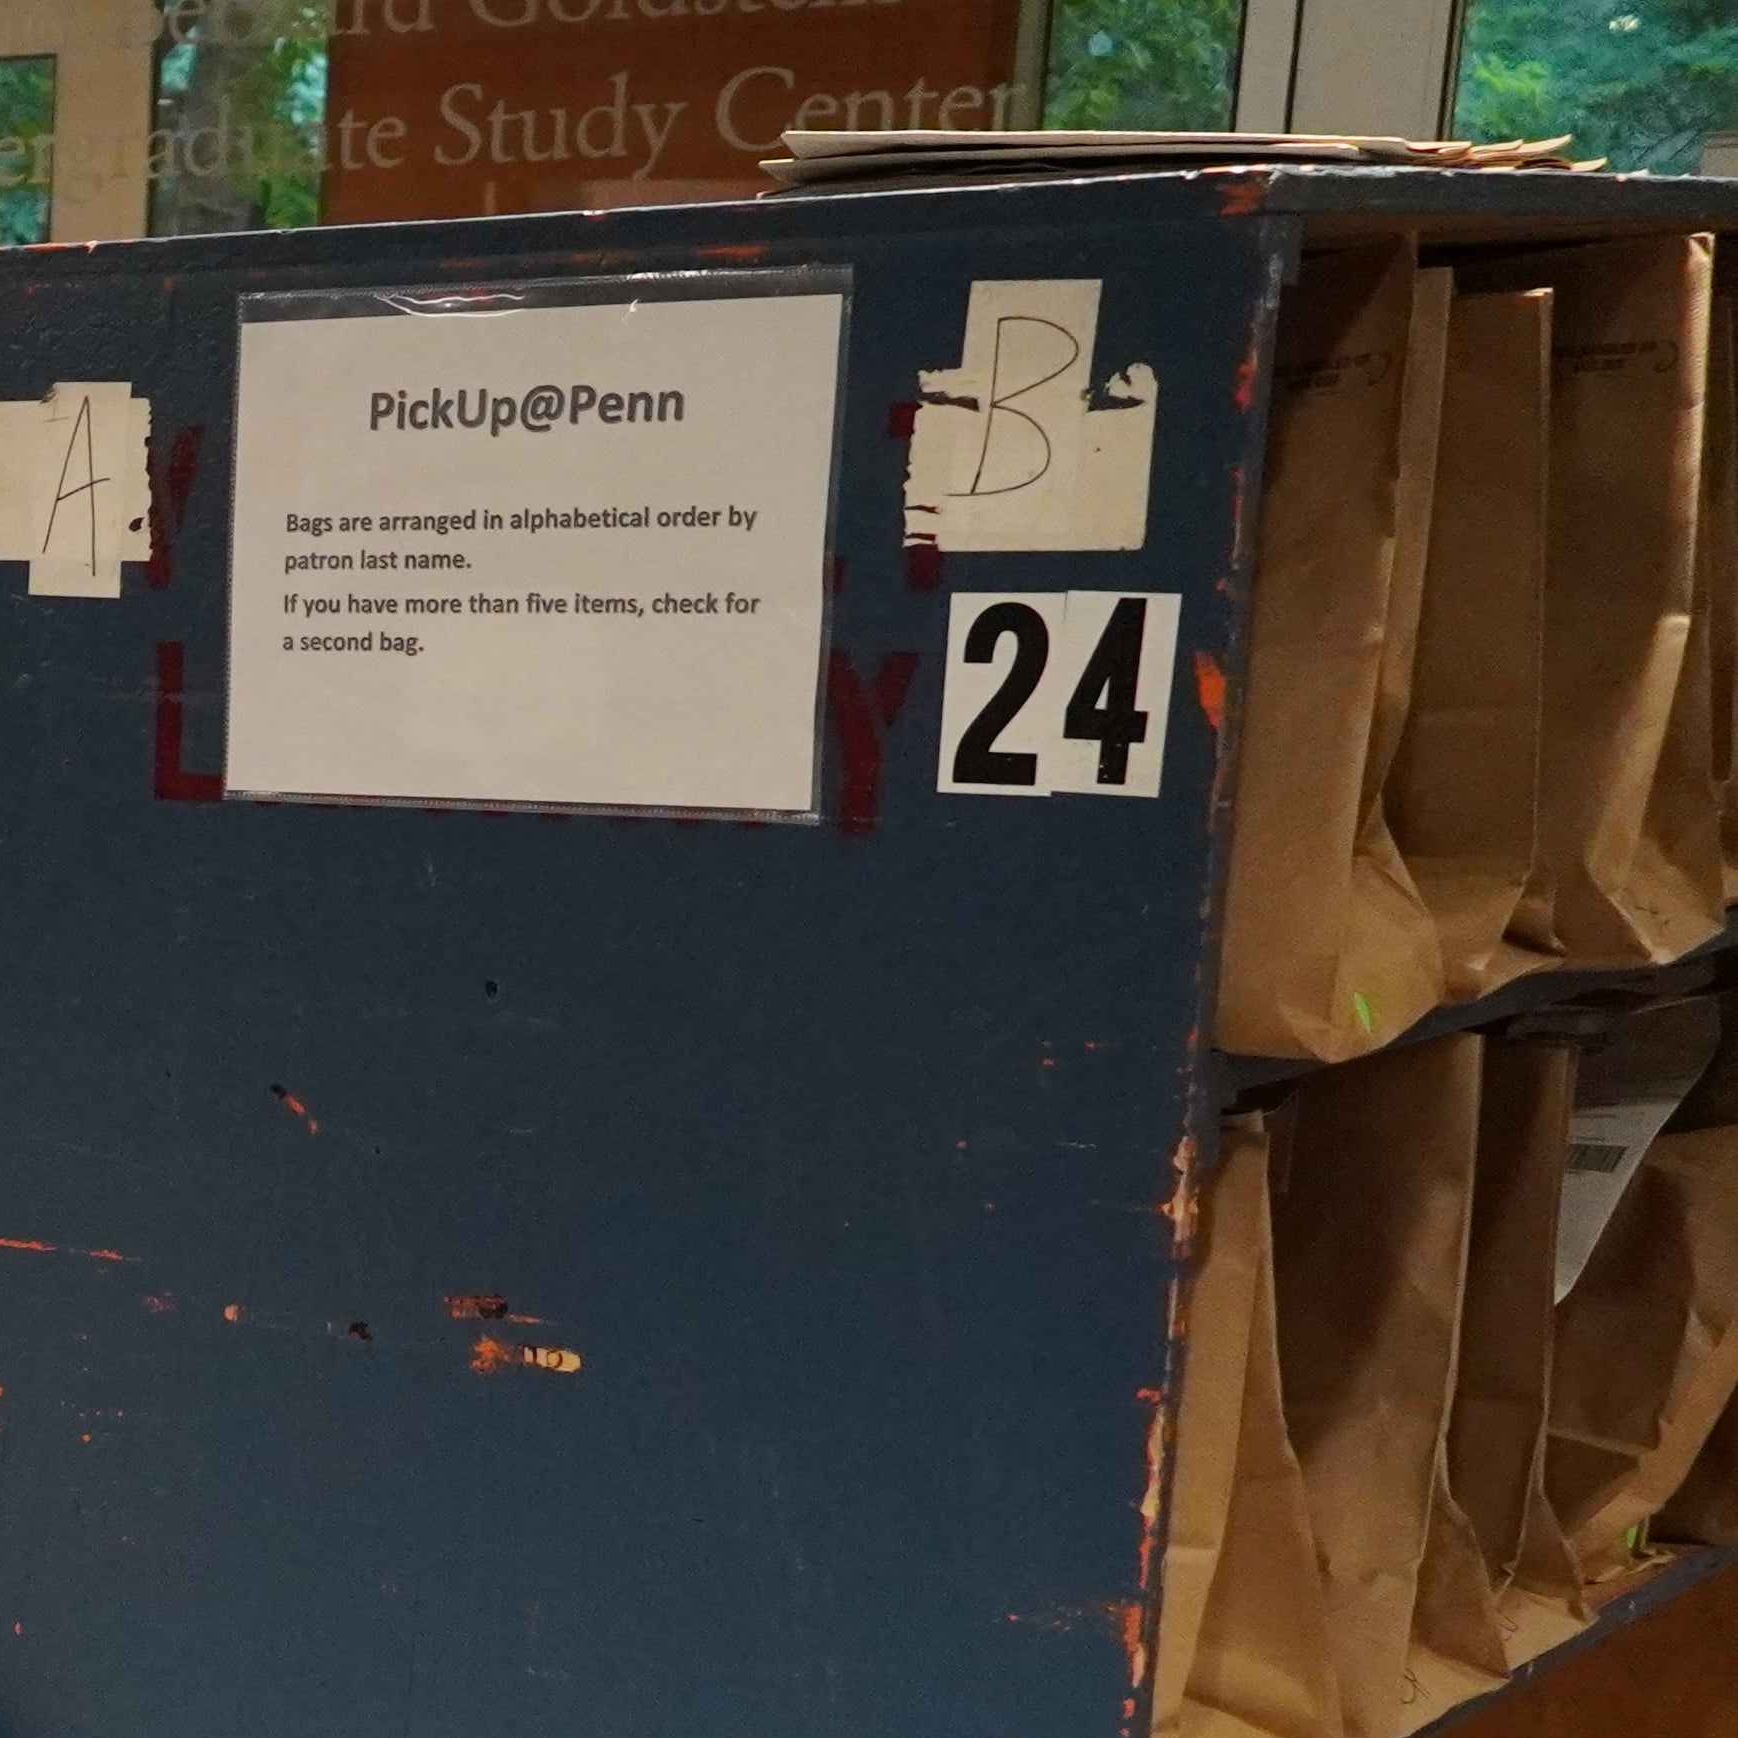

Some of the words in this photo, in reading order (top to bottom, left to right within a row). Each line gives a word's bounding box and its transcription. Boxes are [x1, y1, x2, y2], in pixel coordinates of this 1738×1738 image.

[434, 70, 687, 181] Study
[369, 384, 685, 438] PickUp@Penn
[941, 315, 1080, 497] B
[42, 395, 111, 578] A
[286, 513, 334, 538] Bags
[339, 515, 373, 533] are
[379, 509, 477, 536] arranged
[483, 508, 504, 530] in
[510, 505, 651, 534] alphabetical
[656, 504, 723, 528] order
[728, 504, 759, 532] by
[284, 551, 354, 575] patron
[360, 548, 399, 570] last
[404, 553, 472, 570] name.
[283, 592, 300, 614] If
[303, 598, 341, 619] you
[348, 592, 399, 615] have
[405, 598, 463, 615] more
[468, 592, 520, 614] than
[525, 592, 568, 614] five
[574, 592, 645, 619] items,
[651, 591, 719, 615] check
[724, 591, 761, 615] for
[282, 635, 294, 652] a
[299, 630, 374, 652] second
[379, 630, 425, 657] bag.
[952, 597, 1150, 787] 24
